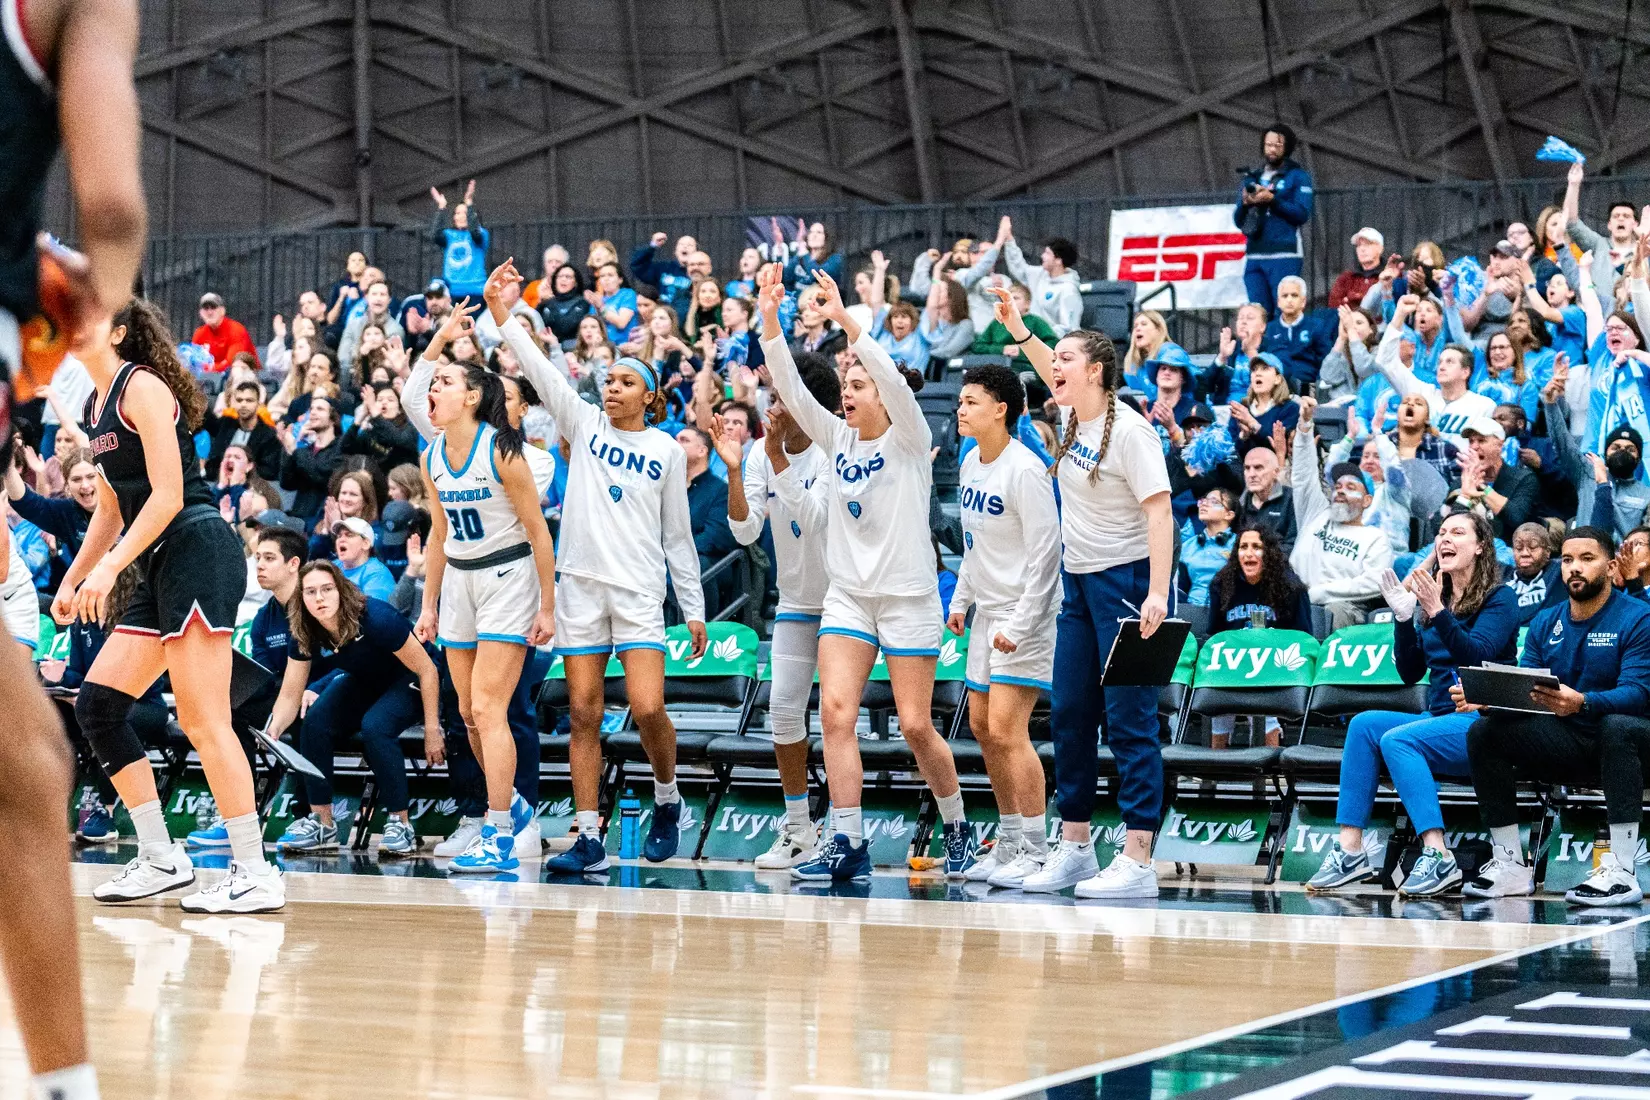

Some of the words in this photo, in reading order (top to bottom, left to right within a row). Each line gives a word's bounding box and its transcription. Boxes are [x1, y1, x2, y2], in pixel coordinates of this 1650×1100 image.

[1118, 233, 1247, 281] ESP
[590, 434, 662, 481] LIONS
[438, 487, 492, 503] LUMBIA
[961, 485, 1005, 516] ONS
[1206, 640, 1273, 679] Ivy
[1321, 637, 1390, 677] Ivy
[716, 806, 771, 840] Ivy
[1166, 813, 1229, 846] Ivy
[1291, 824, 1341, 853] Iv
[1555, 833, 1594, 862] Iv
